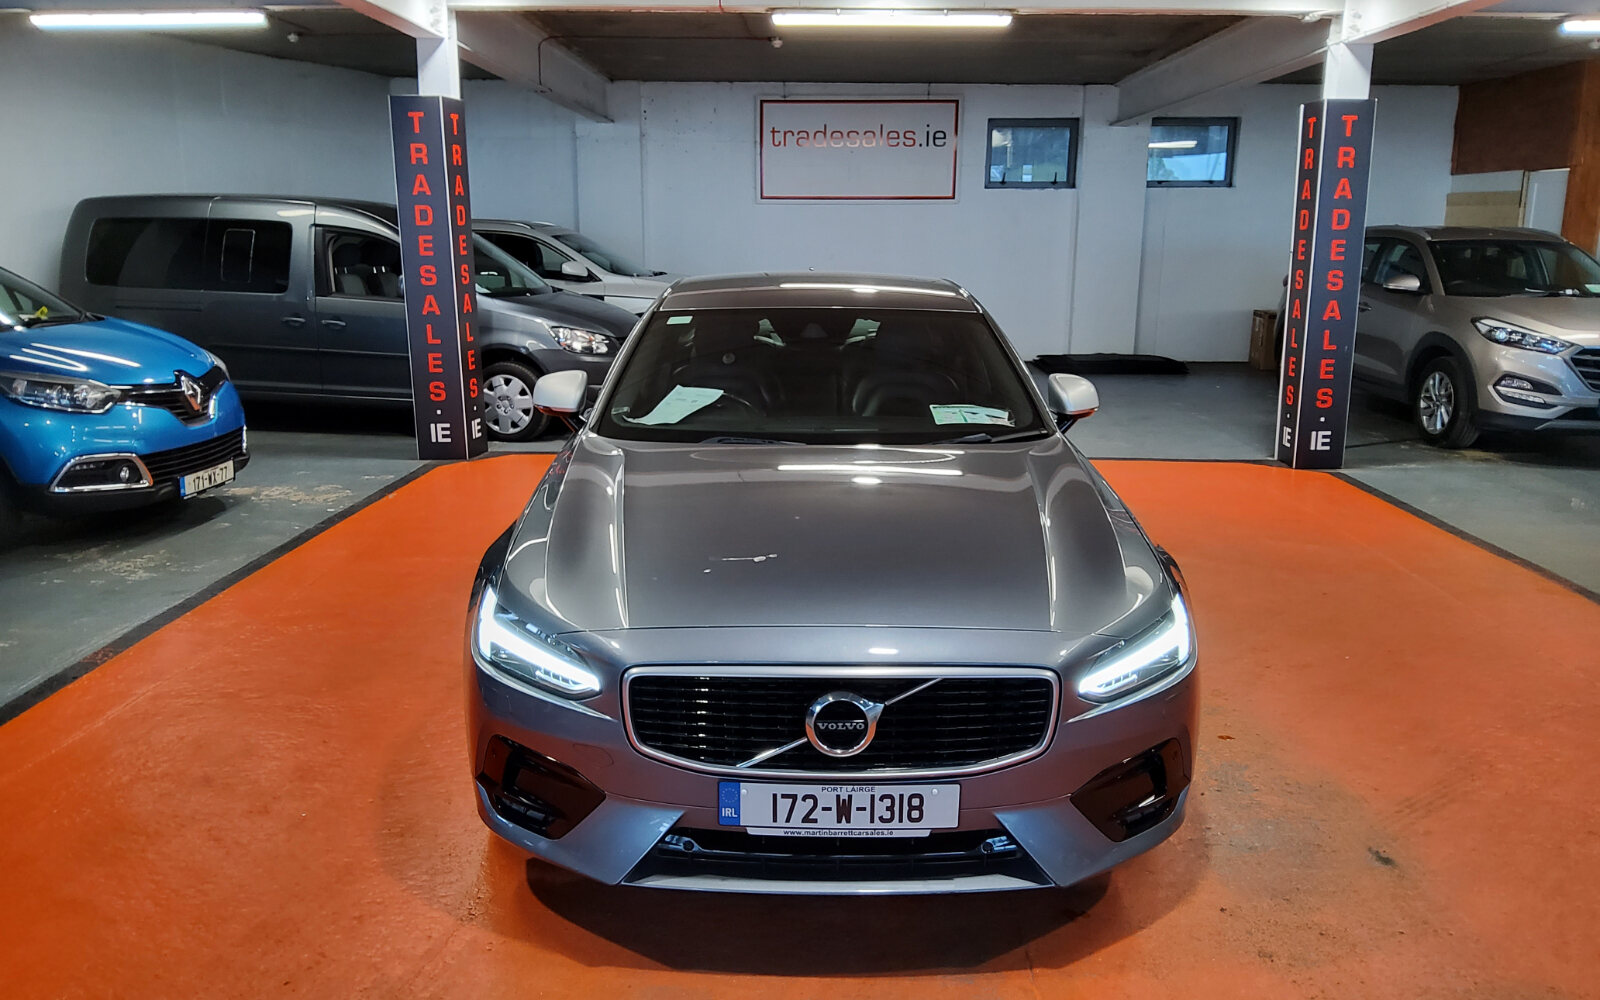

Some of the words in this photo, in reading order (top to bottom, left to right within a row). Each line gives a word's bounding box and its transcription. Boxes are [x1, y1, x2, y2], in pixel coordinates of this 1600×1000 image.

[770, 124, 947, 148] tradesales.ie
[817, 722, 865, 730] VOLVO
[721, 807, 738, 818] IRL
[772, 793, 924, 824] 172-W-1318
